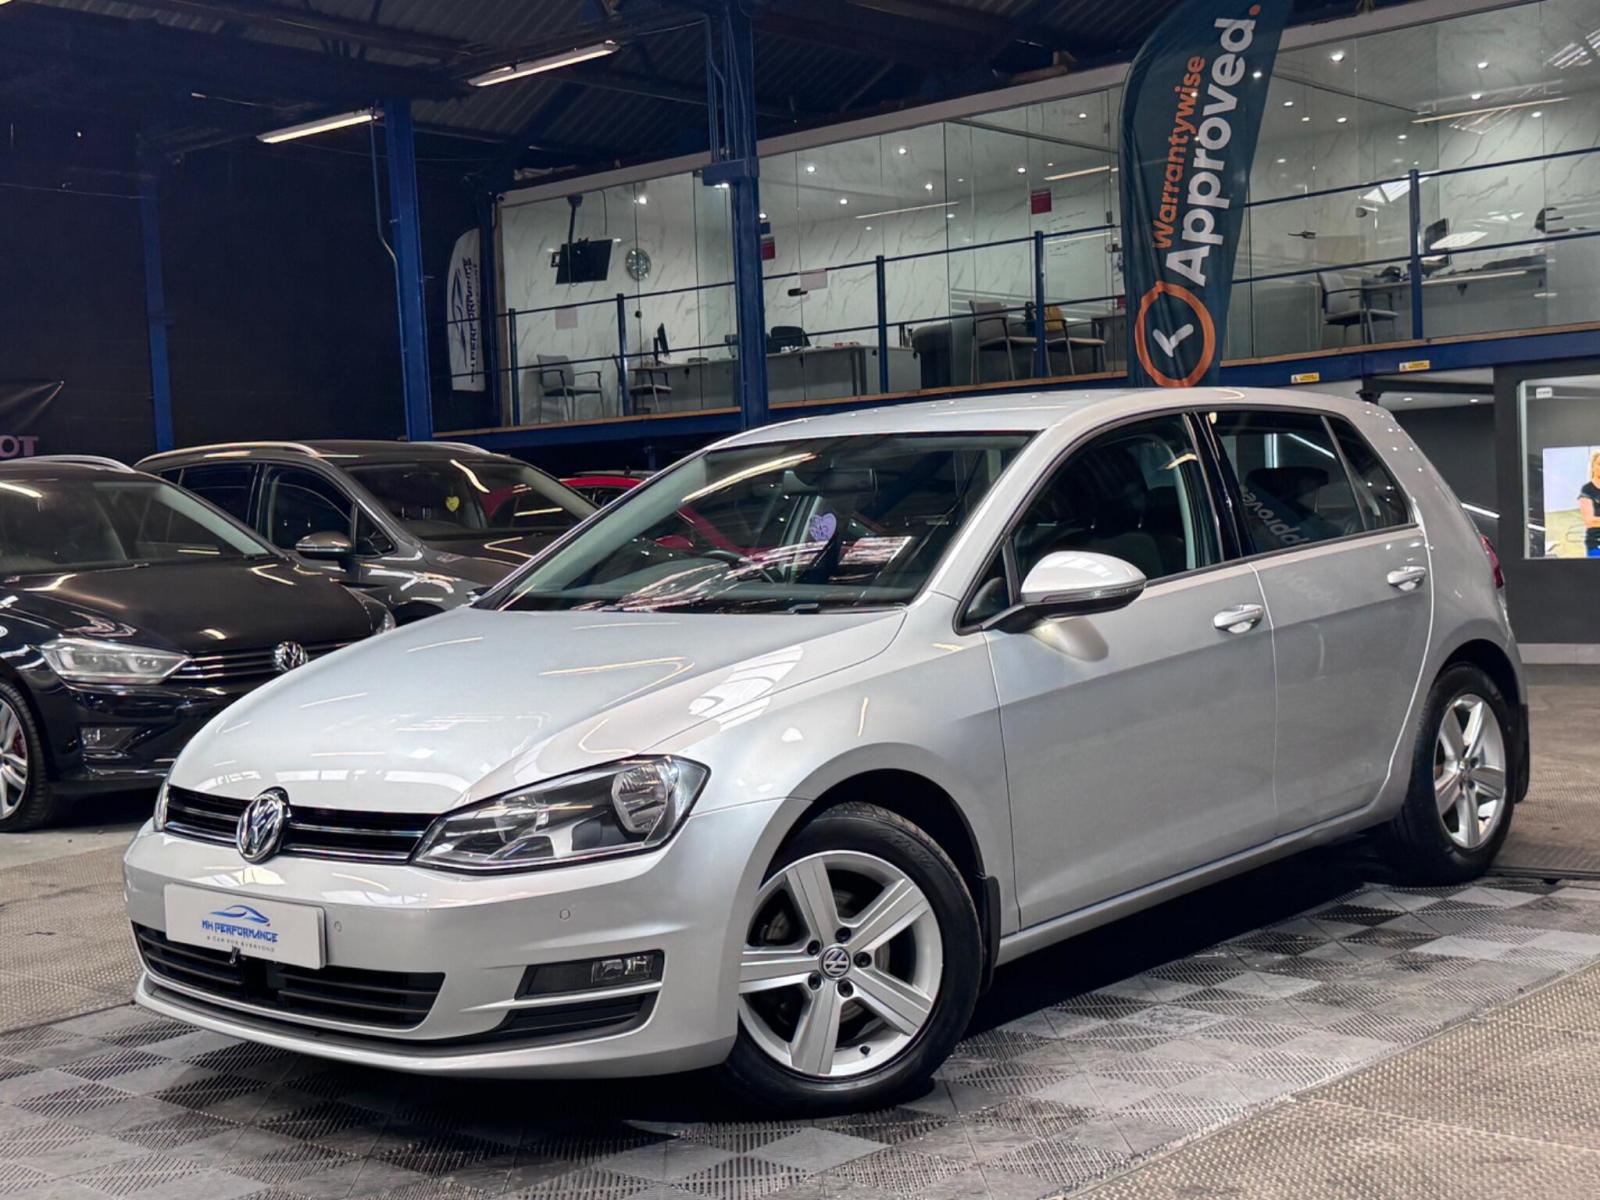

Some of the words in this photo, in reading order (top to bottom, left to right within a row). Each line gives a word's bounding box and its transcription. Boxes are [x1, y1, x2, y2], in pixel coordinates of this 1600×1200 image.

[1152, 55, 1206, 249] Warrantywise
[1165, 4, 1261, 287] Approved.
[215, 922, 279, 943] PERFORMANCE
